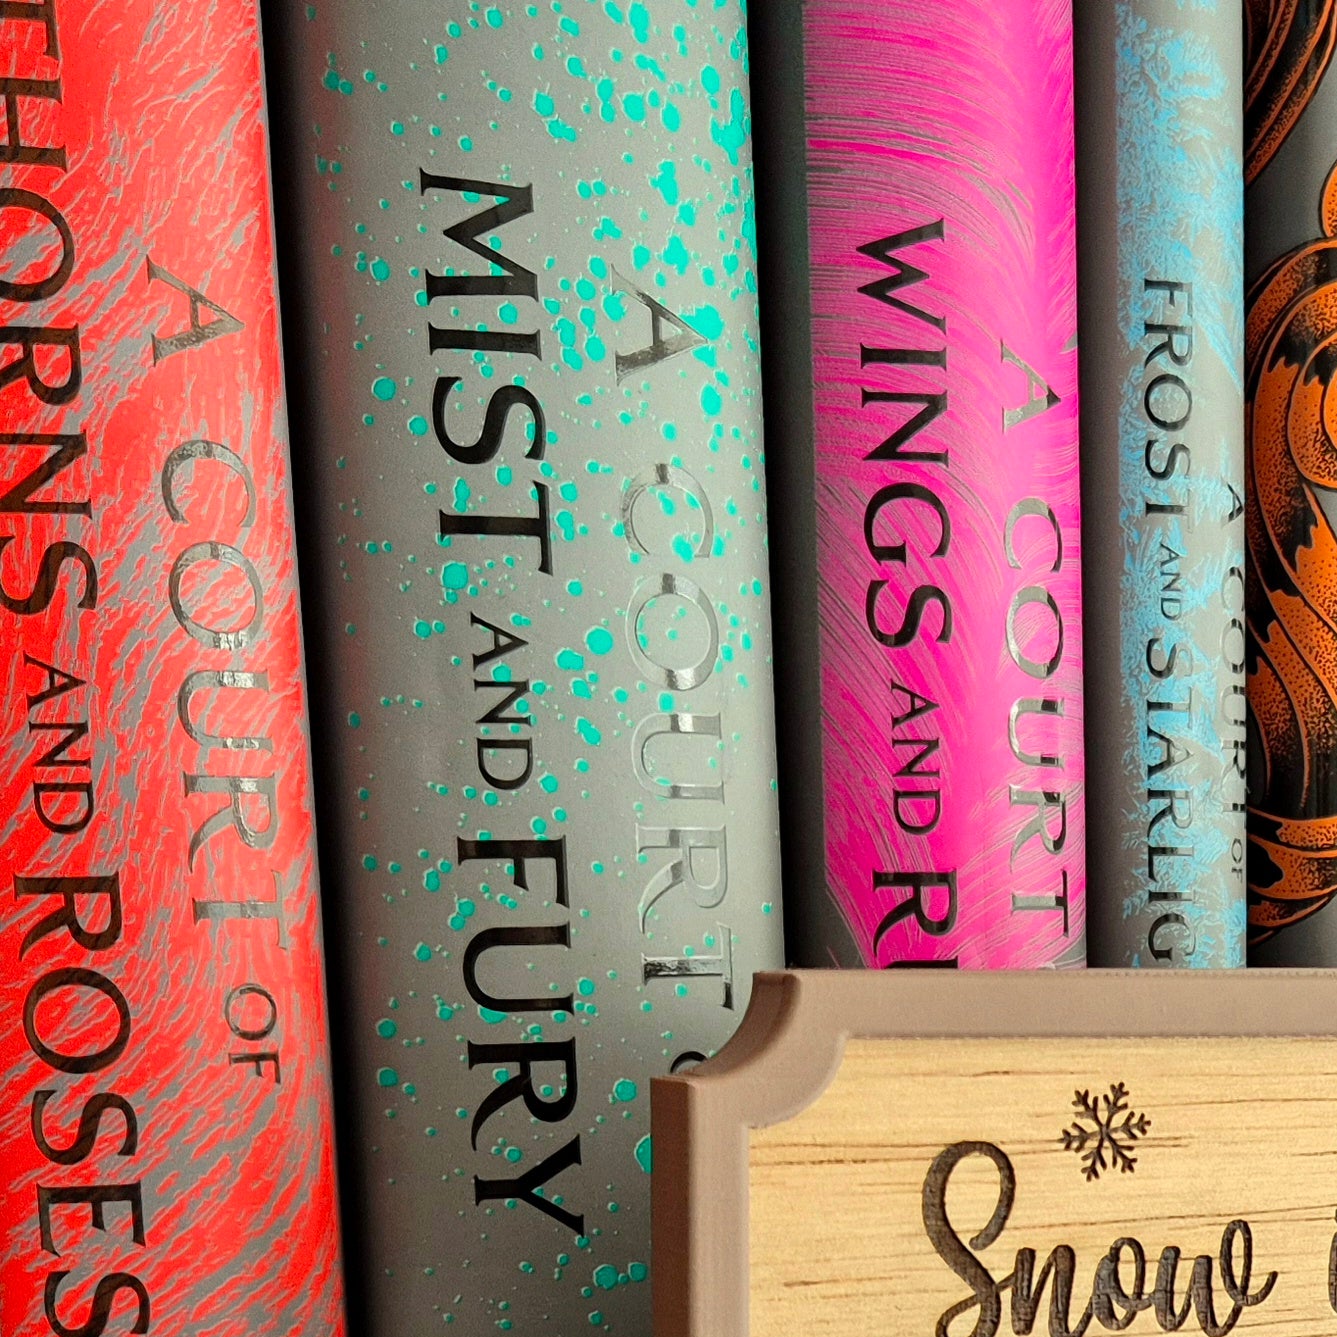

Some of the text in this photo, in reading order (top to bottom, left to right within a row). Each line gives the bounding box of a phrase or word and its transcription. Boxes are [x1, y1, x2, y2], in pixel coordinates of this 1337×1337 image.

[855, 218, 954, 651] WINGS
[1143, 277, 1194, 535] FROST
[1221, 482, 1246, 529] A
[145, 253, 287, 1084] A COURT OF
[418, 166, 585, 1238] MIST AND FURY
[610, 262, 736, 1012] A COURT
[1000, 338, 1071, 938] A COURT
[1159, 542, 1183, 621] AND
[1220, 566, 1247, 830] COURT
[22, 652, 93, 835] AND
[888, 682, 942, 837] AND
